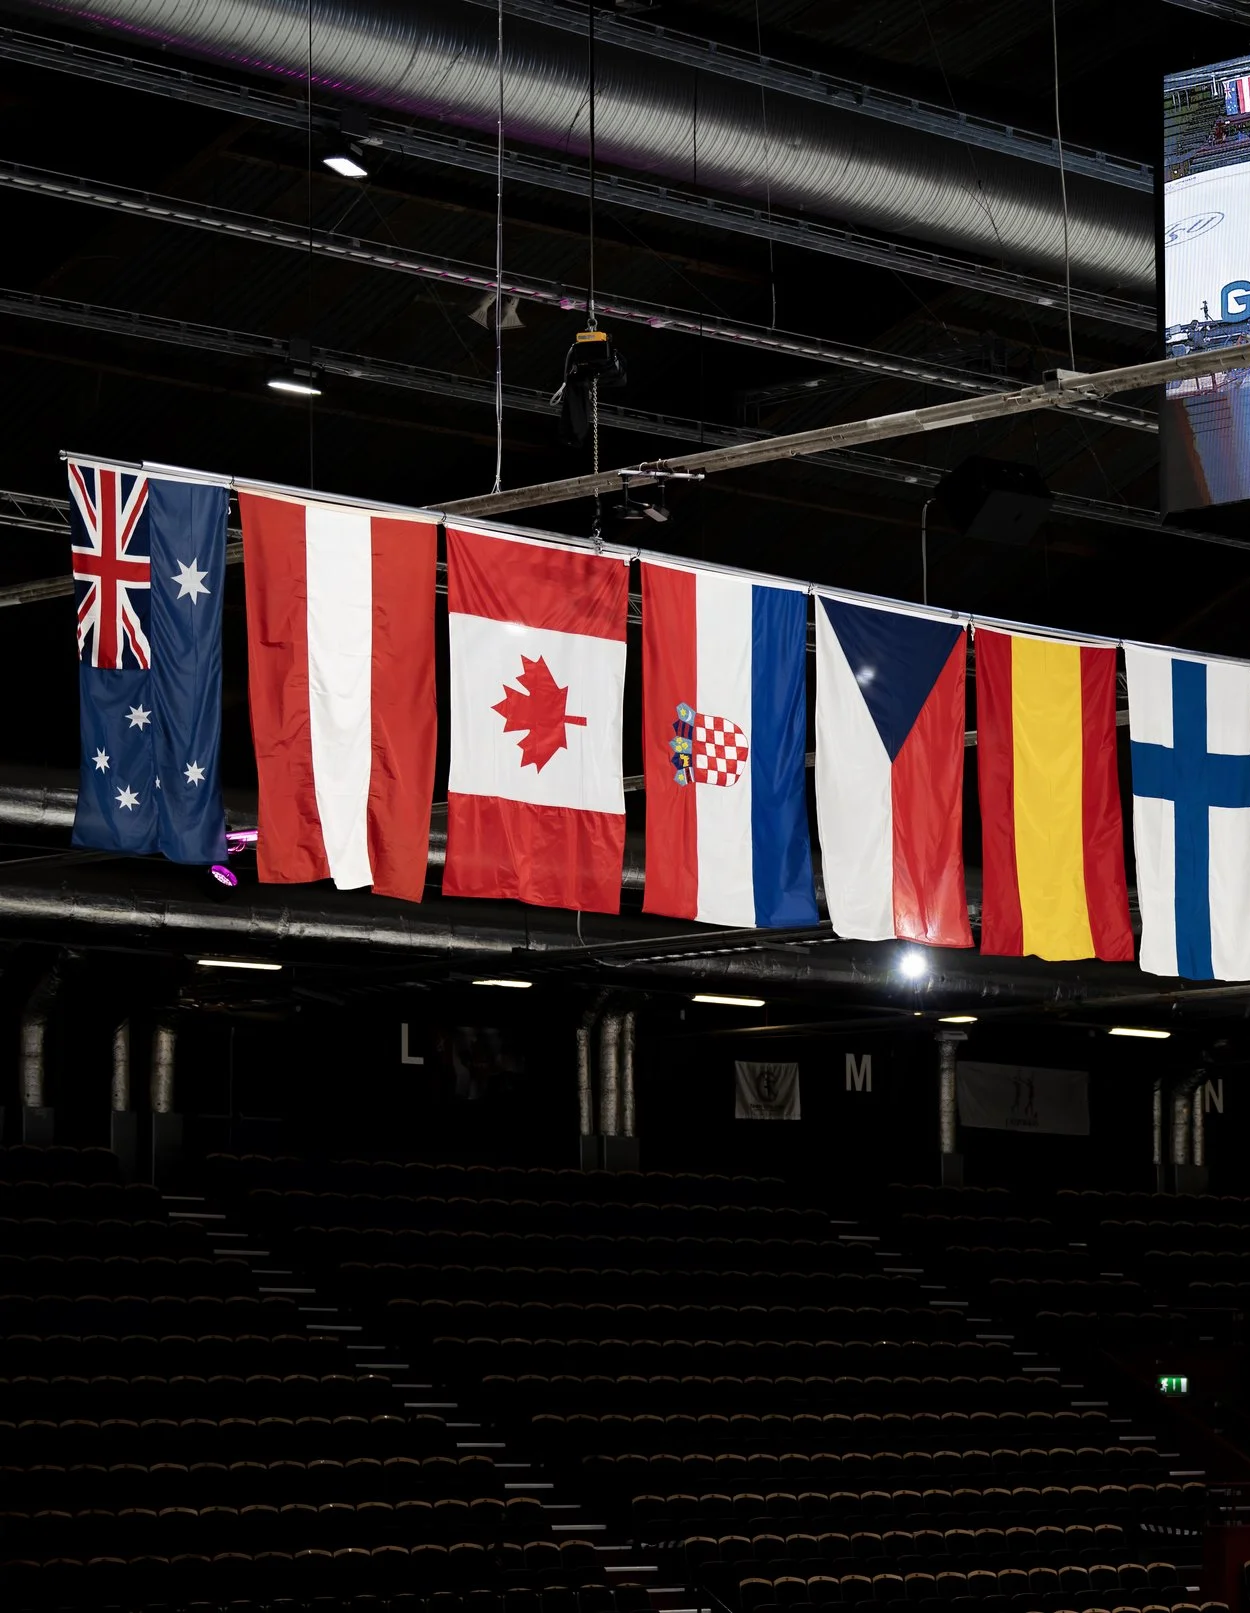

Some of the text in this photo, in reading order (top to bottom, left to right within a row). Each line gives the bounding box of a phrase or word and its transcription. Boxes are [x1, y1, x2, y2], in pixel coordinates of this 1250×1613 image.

[401, 1023, 424, 1065] L
[845, 1053, 872, 1092] M
[1204, 1078, 1224, 1114] N
